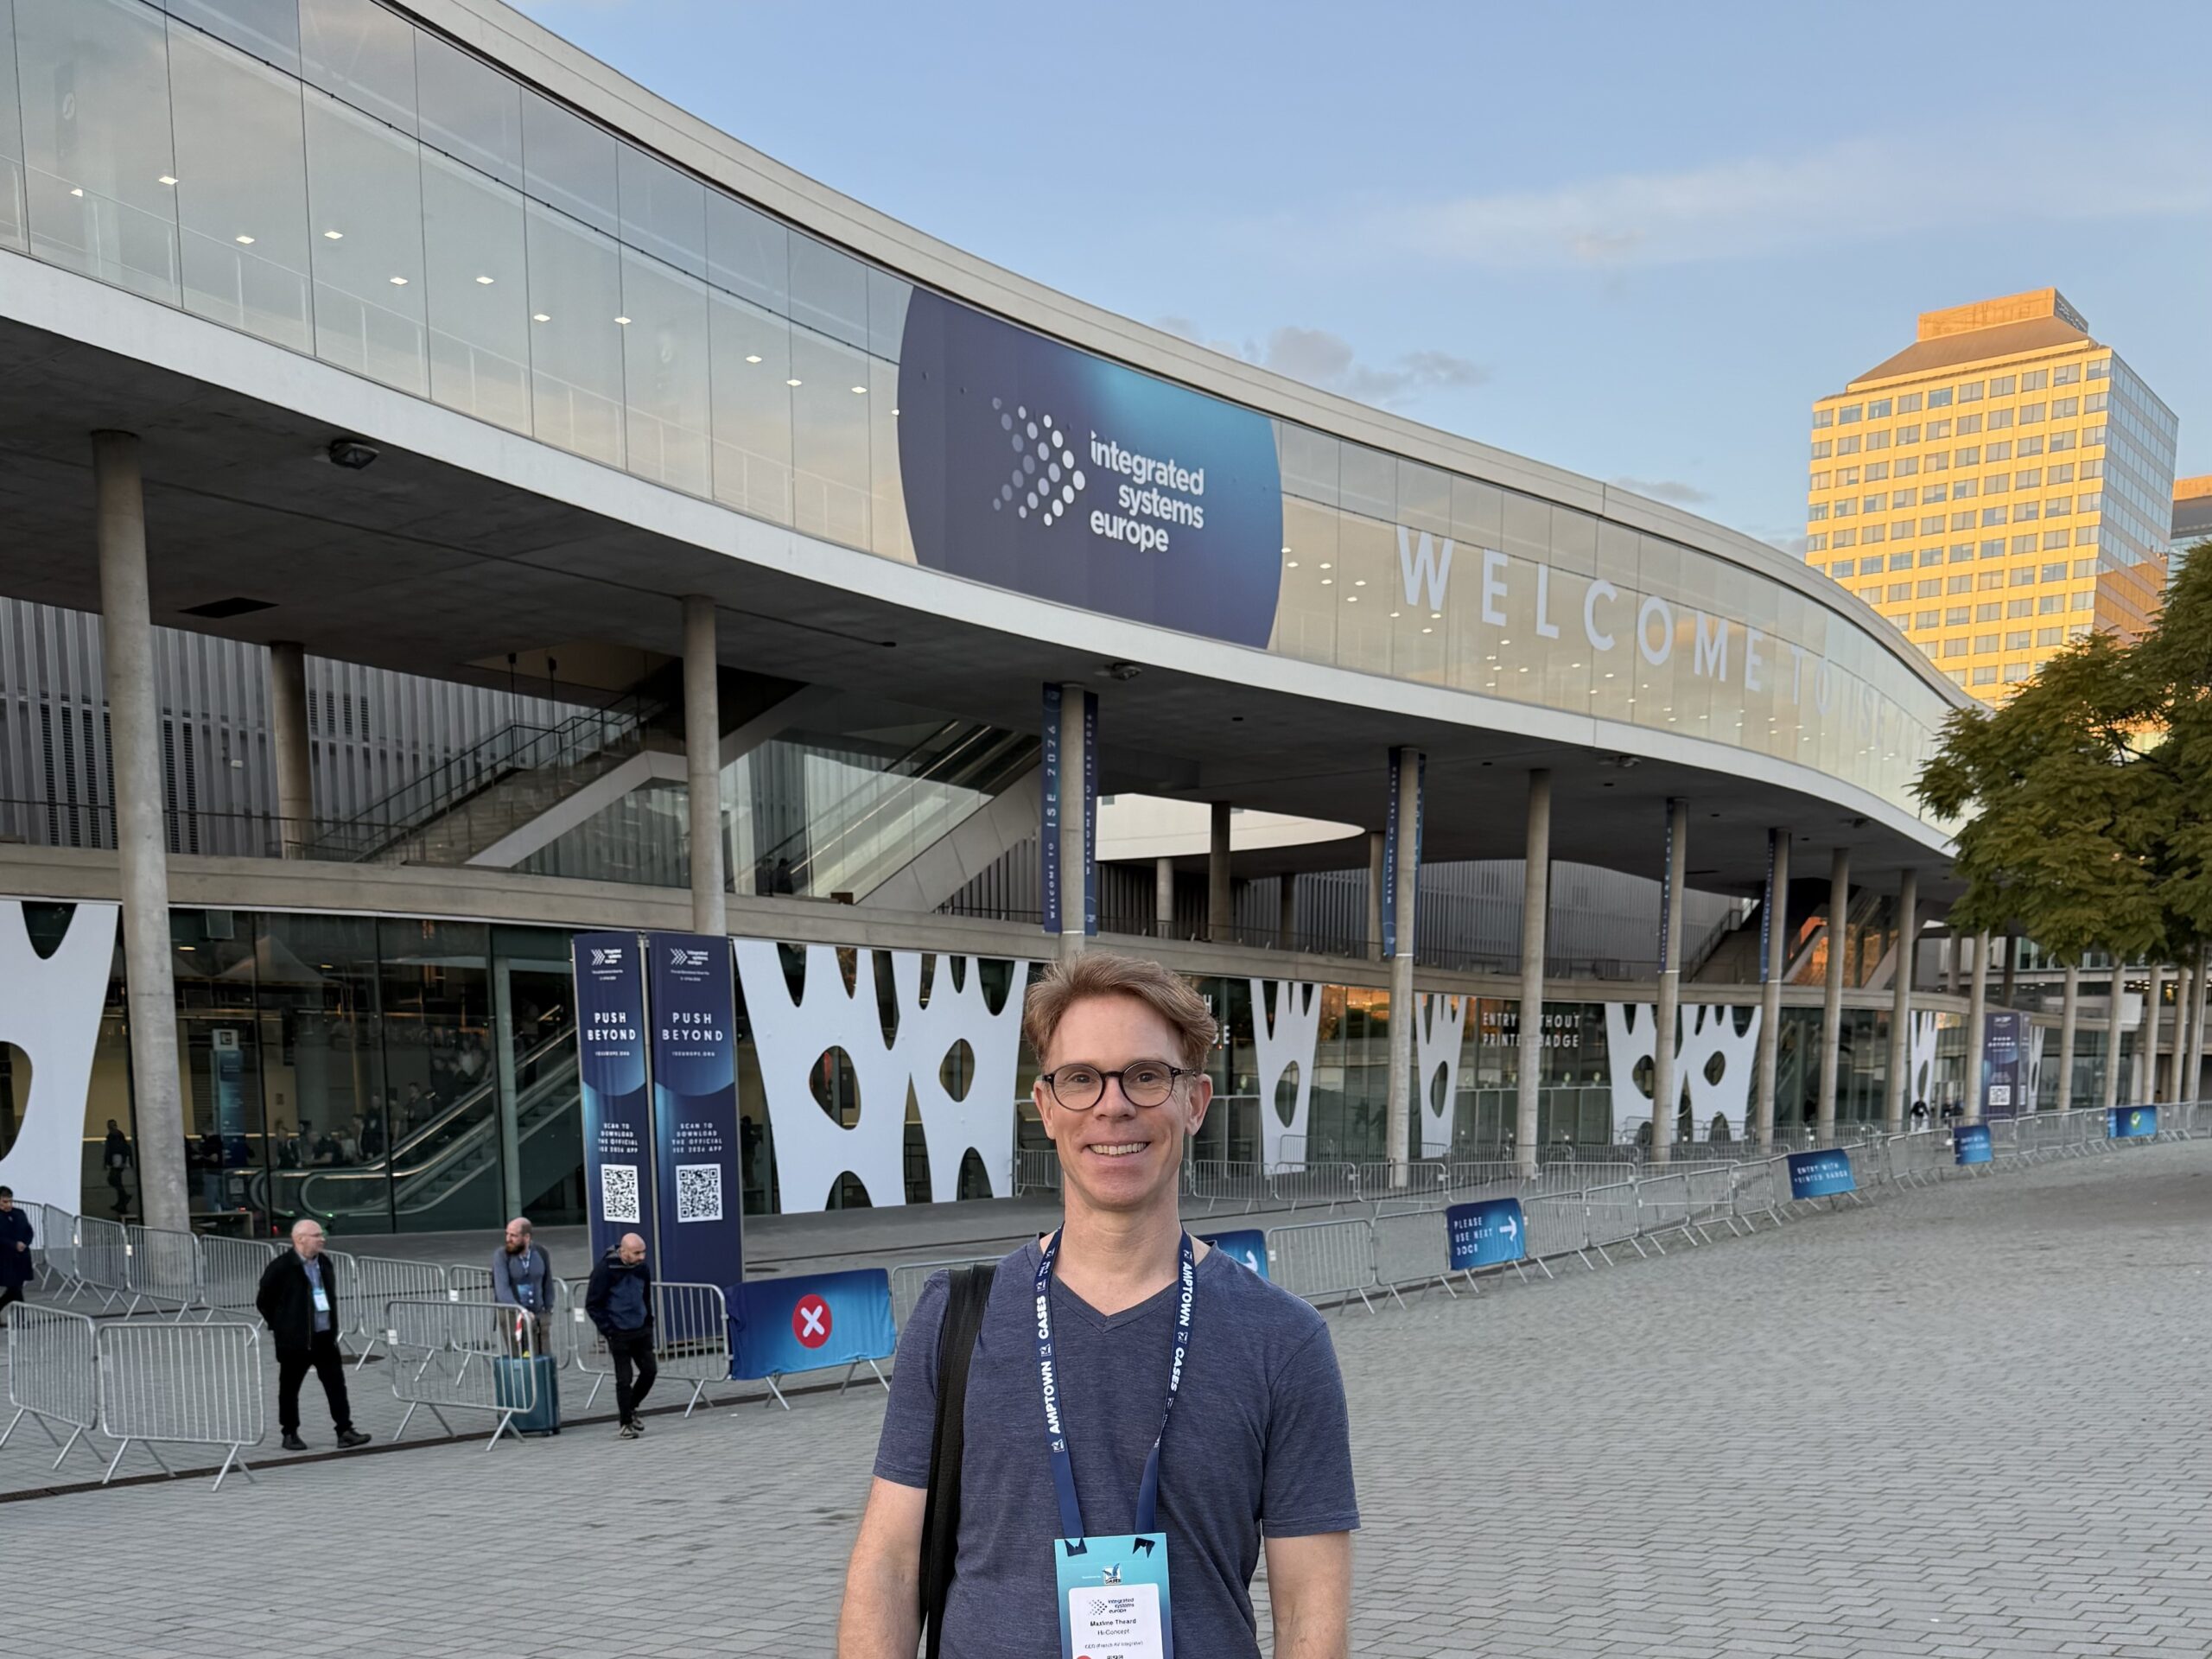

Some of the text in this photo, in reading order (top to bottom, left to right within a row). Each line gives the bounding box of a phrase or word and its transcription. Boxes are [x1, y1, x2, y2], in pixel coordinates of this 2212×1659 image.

[1090, 430, 1205, 495] integrated
[1118, 485, 1204, 529] systems
[1090, 510, 1169, 552] europe
[1396, 525, 1764, 692] WELCOME
[1790, 645, 1833, 715] TO
[1047, 725, 1057, 776] 2026
[1046, 793, 1057, 827] ISE
[1048, 842, 1055, 856] TO
[594, 1012, 626, 1024] PUSH
[672, 1012, 712, 1024] PUSH
[1483, 1012, 1580, 1028] ENTRY THOUT
[587, 1028, 637, 1041] BEYOND
[662, 1028, 723, 1041] BEYOND
[1483, 1033, 1521, 1047] PRINTE
[1453, 1217, 1482, 1230] PLEASE
[1455, 1228, 1493, 1243] USE NEXT
[1036, 1295, 1050, 1340] CASES
[1170, 1262, 1194, 1392] AMPTOWN CASES
[1040, 1360, 1061, 1435] AMPTOWN
